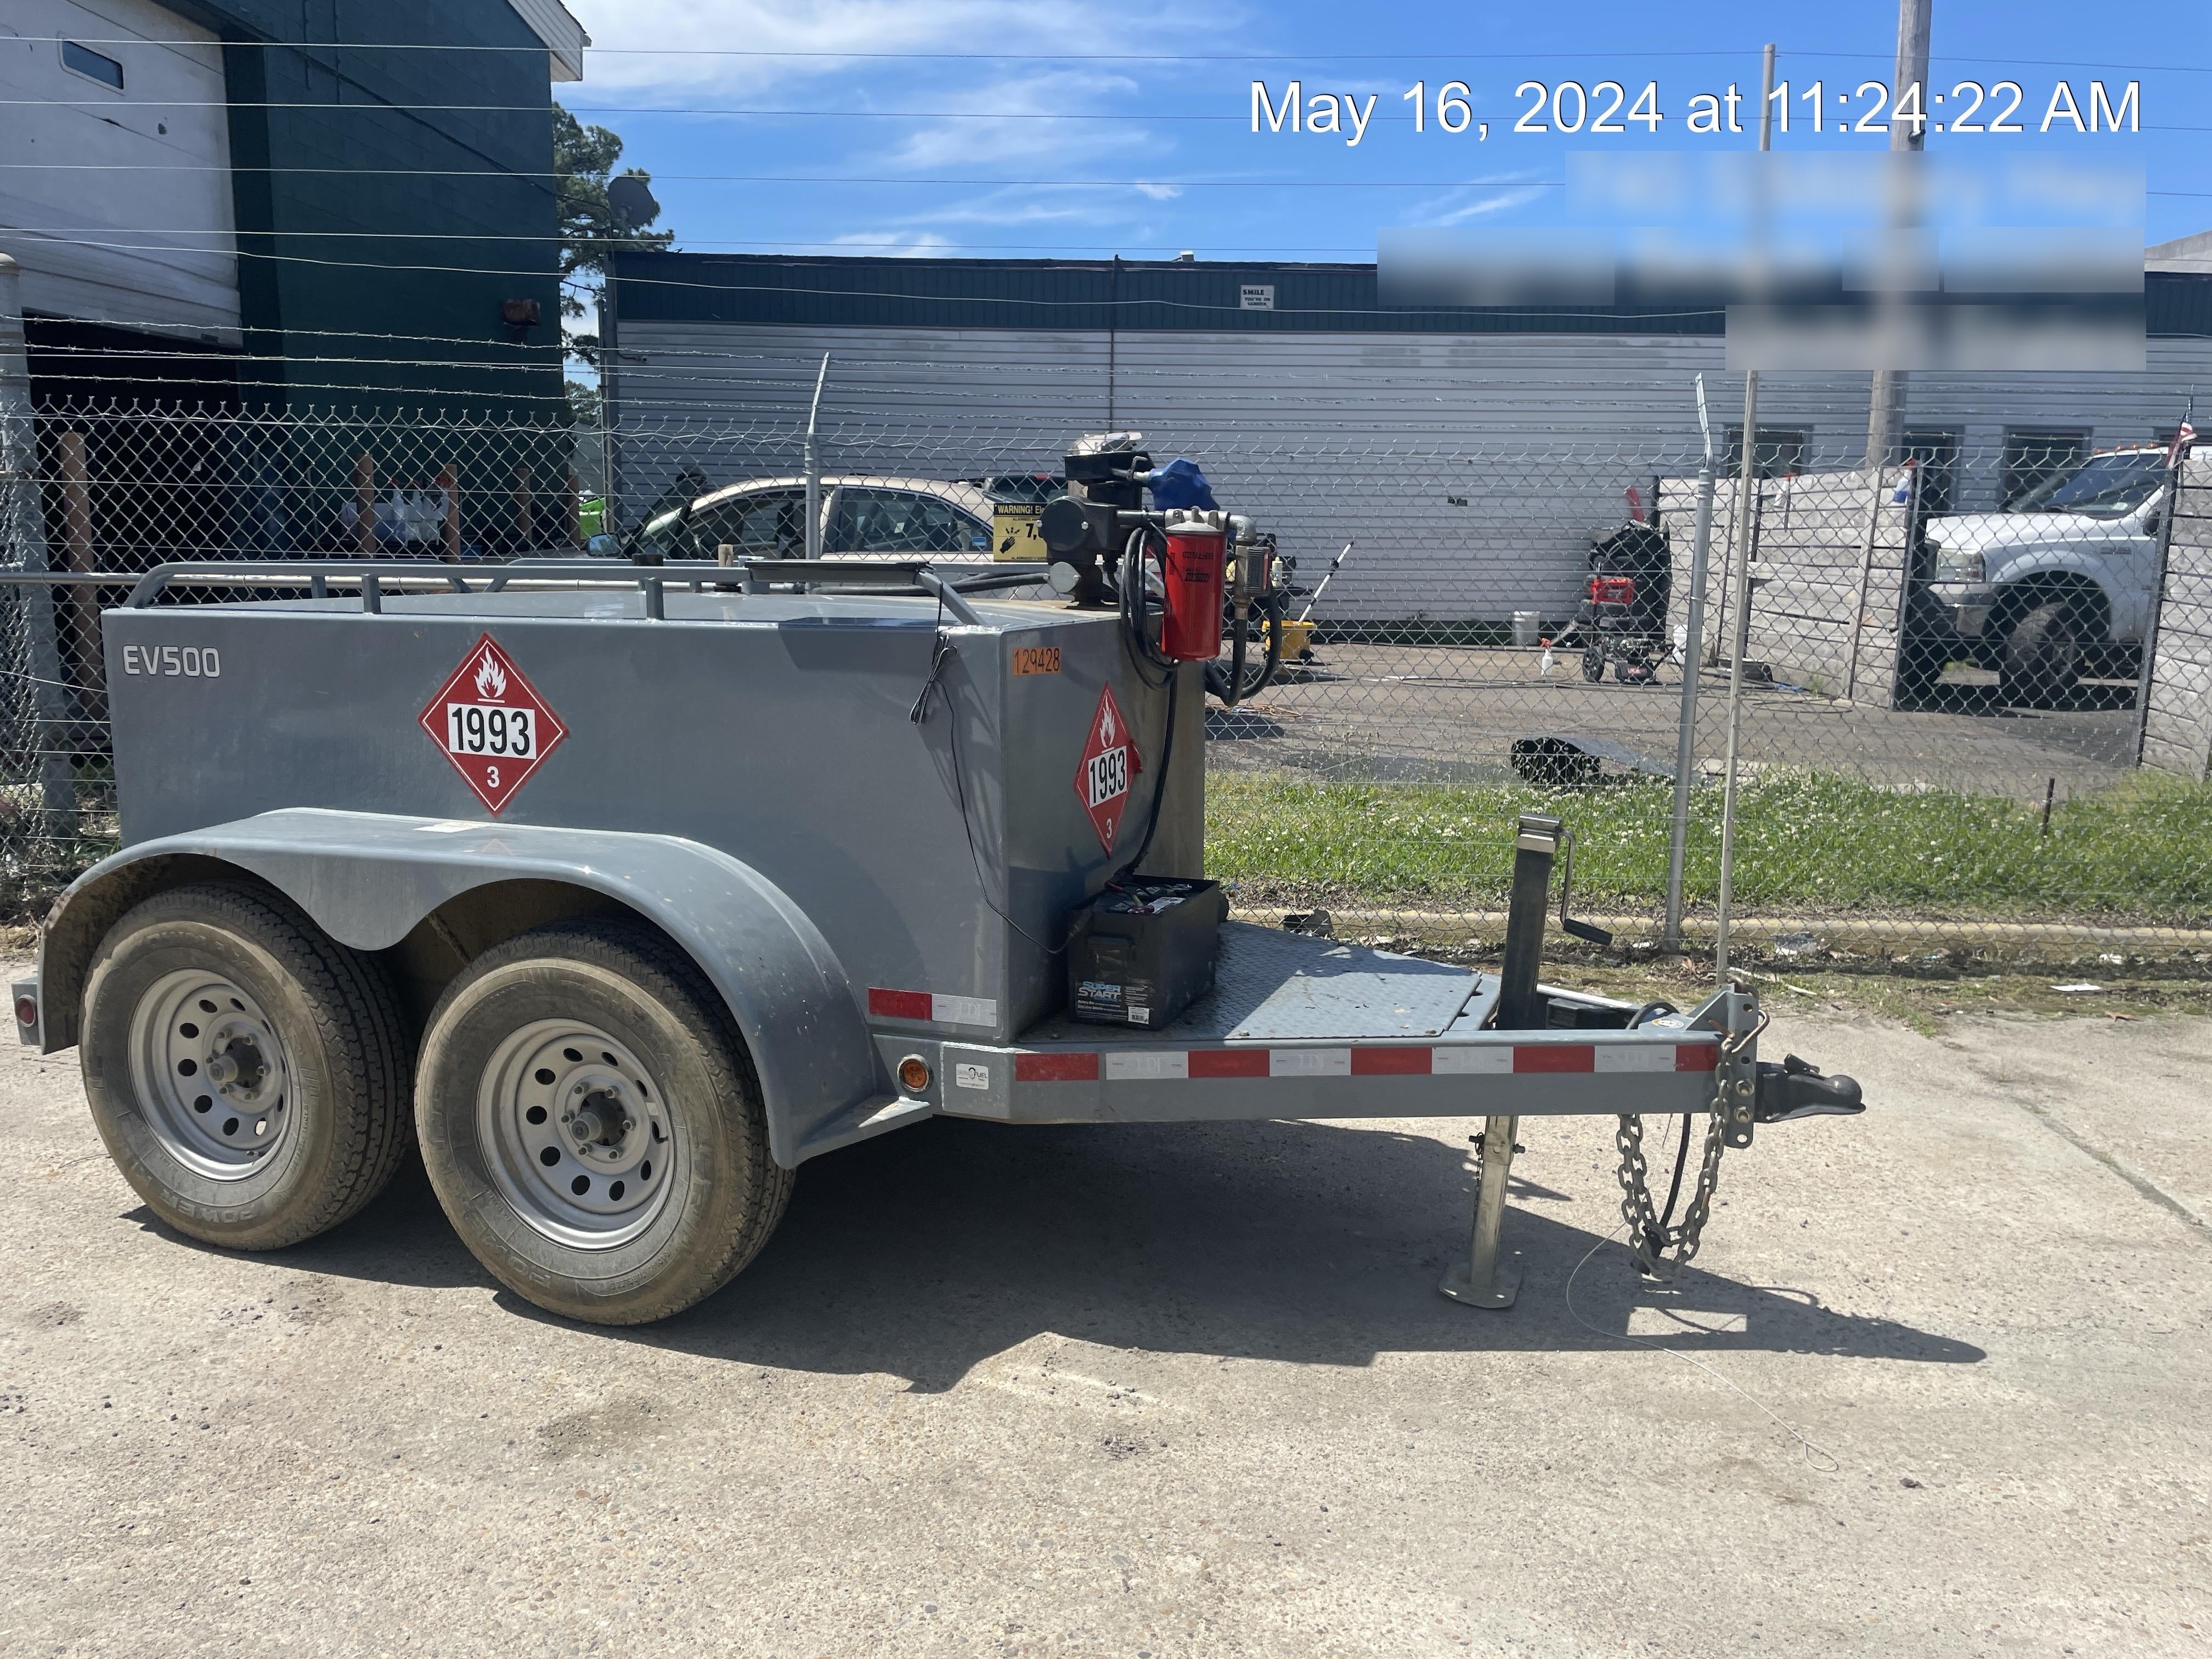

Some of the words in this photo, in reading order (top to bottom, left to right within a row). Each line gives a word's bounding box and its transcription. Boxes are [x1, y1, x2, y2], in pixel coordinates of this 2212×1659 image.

[998, 505, 1033, 514] WARNING!
[123, 645, 220, 678] EV500
[1014, 648, 1059, 676] 129428
[452, 707, 530, 756] 1993
[487, 765, 500, 788] 3
[1090, 749, 1125, 804] 1993
[1106, 818, 1113, 839] 3
[1077, 986, 1121, 999] START
[1083, 981, 1121, 992] SUPER
